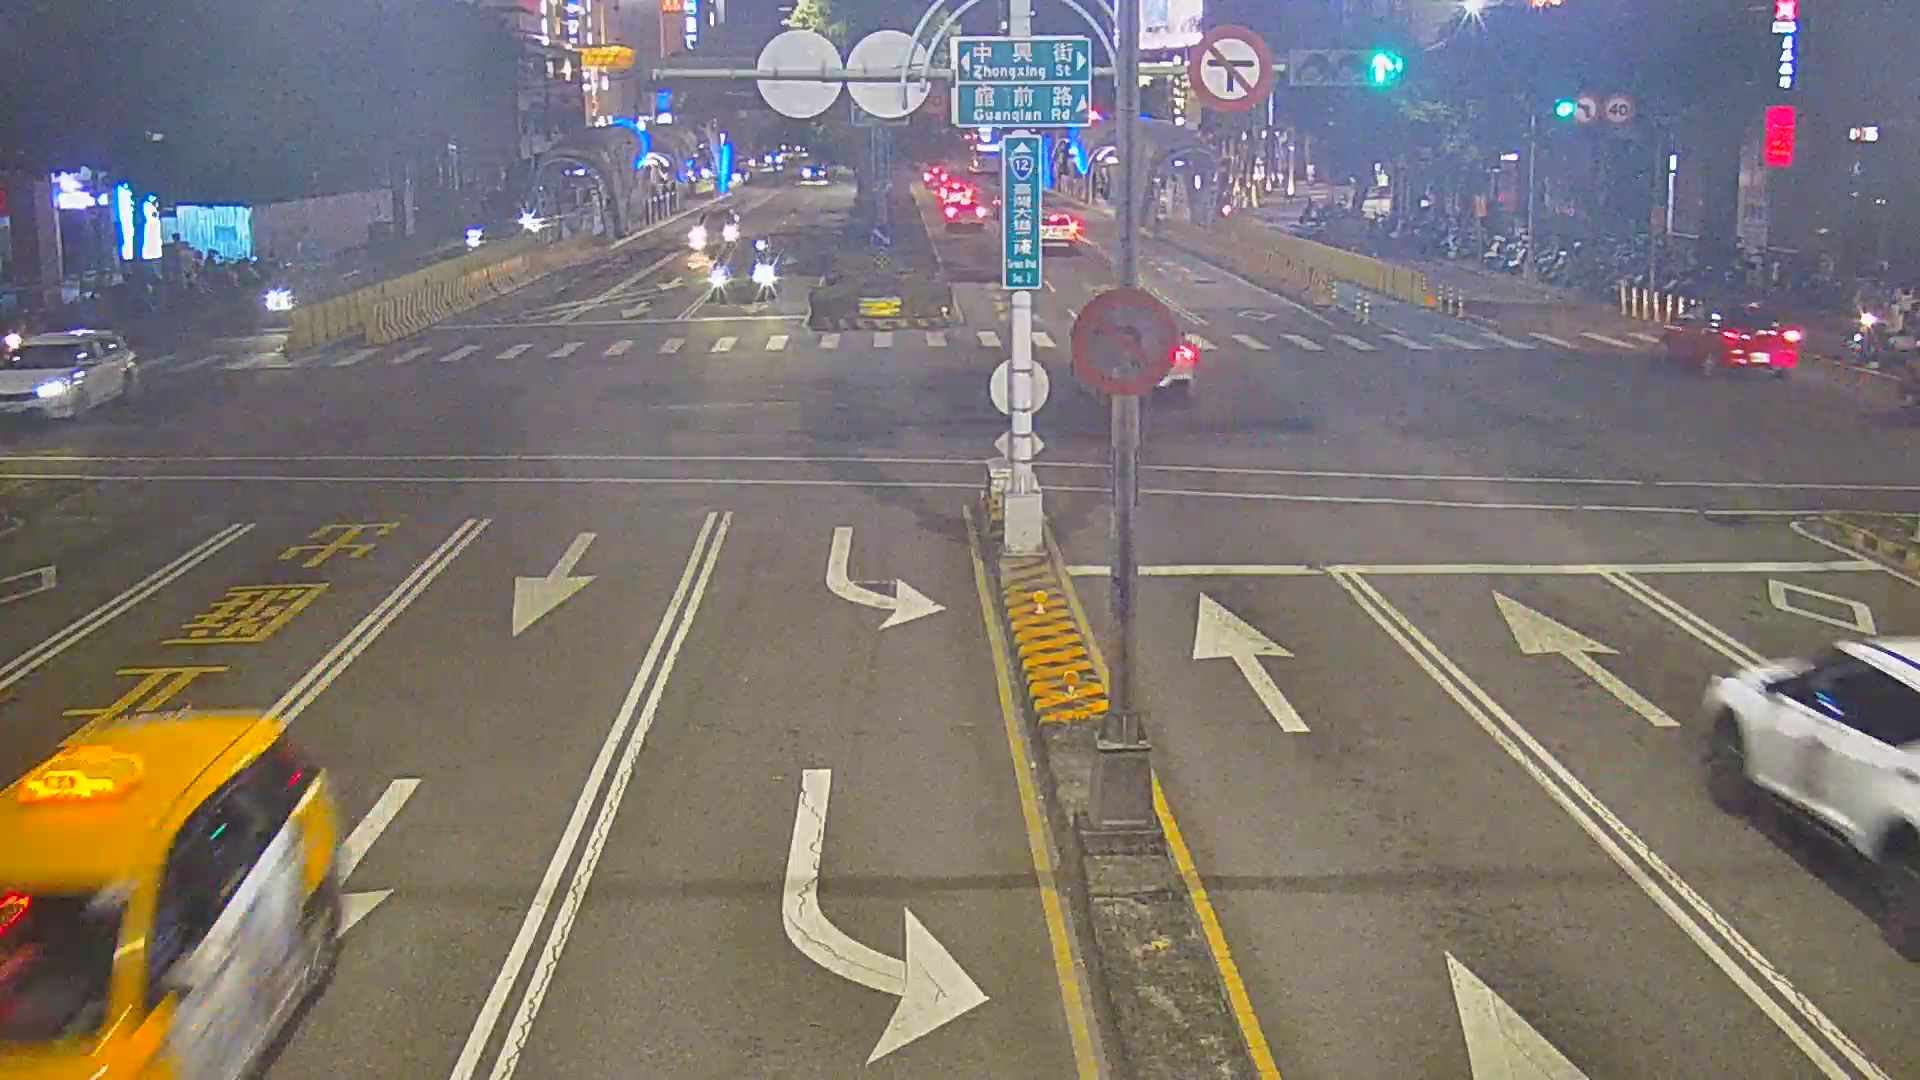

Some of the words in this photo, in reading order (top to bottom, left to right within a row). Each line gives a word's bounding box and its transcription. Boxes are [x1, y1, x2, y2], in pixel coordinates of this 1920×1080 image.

[973, 64, 1046, 80] Zhongxing
[1056, 65, 1072, 77] St
[973, 109, 1042, 122] Guanqian
[1051, 109, 1071, 120] Rd
[1608, 103, 1628, 116] 40
[1014, 159, 1029, 172] 12
